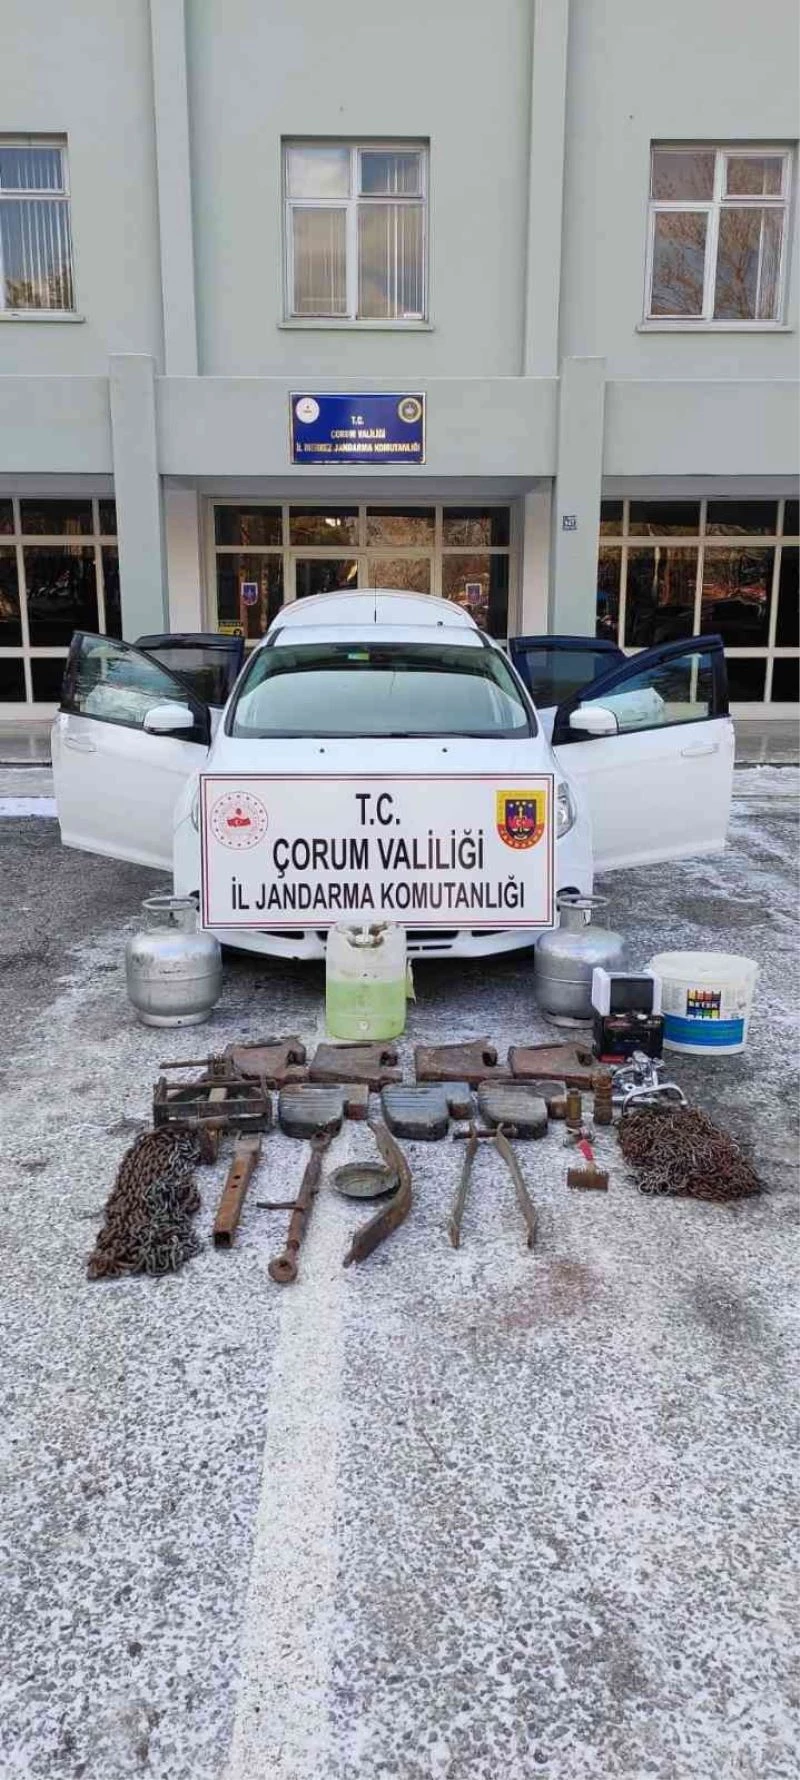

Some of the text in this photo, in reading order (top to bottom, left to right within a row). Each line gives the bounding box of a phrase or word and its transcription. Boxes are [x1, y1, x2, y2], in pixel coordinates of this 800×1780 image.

[351, 416, 364, 425] T.C.
[355, 793, 401, 826] T.C.
[273, 838, 369, 878] ÇORUM
[377, 829, 484, 870] VALİLİĞİ
[231, 875, 525, 910] İL JANDARMA KOMUTANLIĞI
